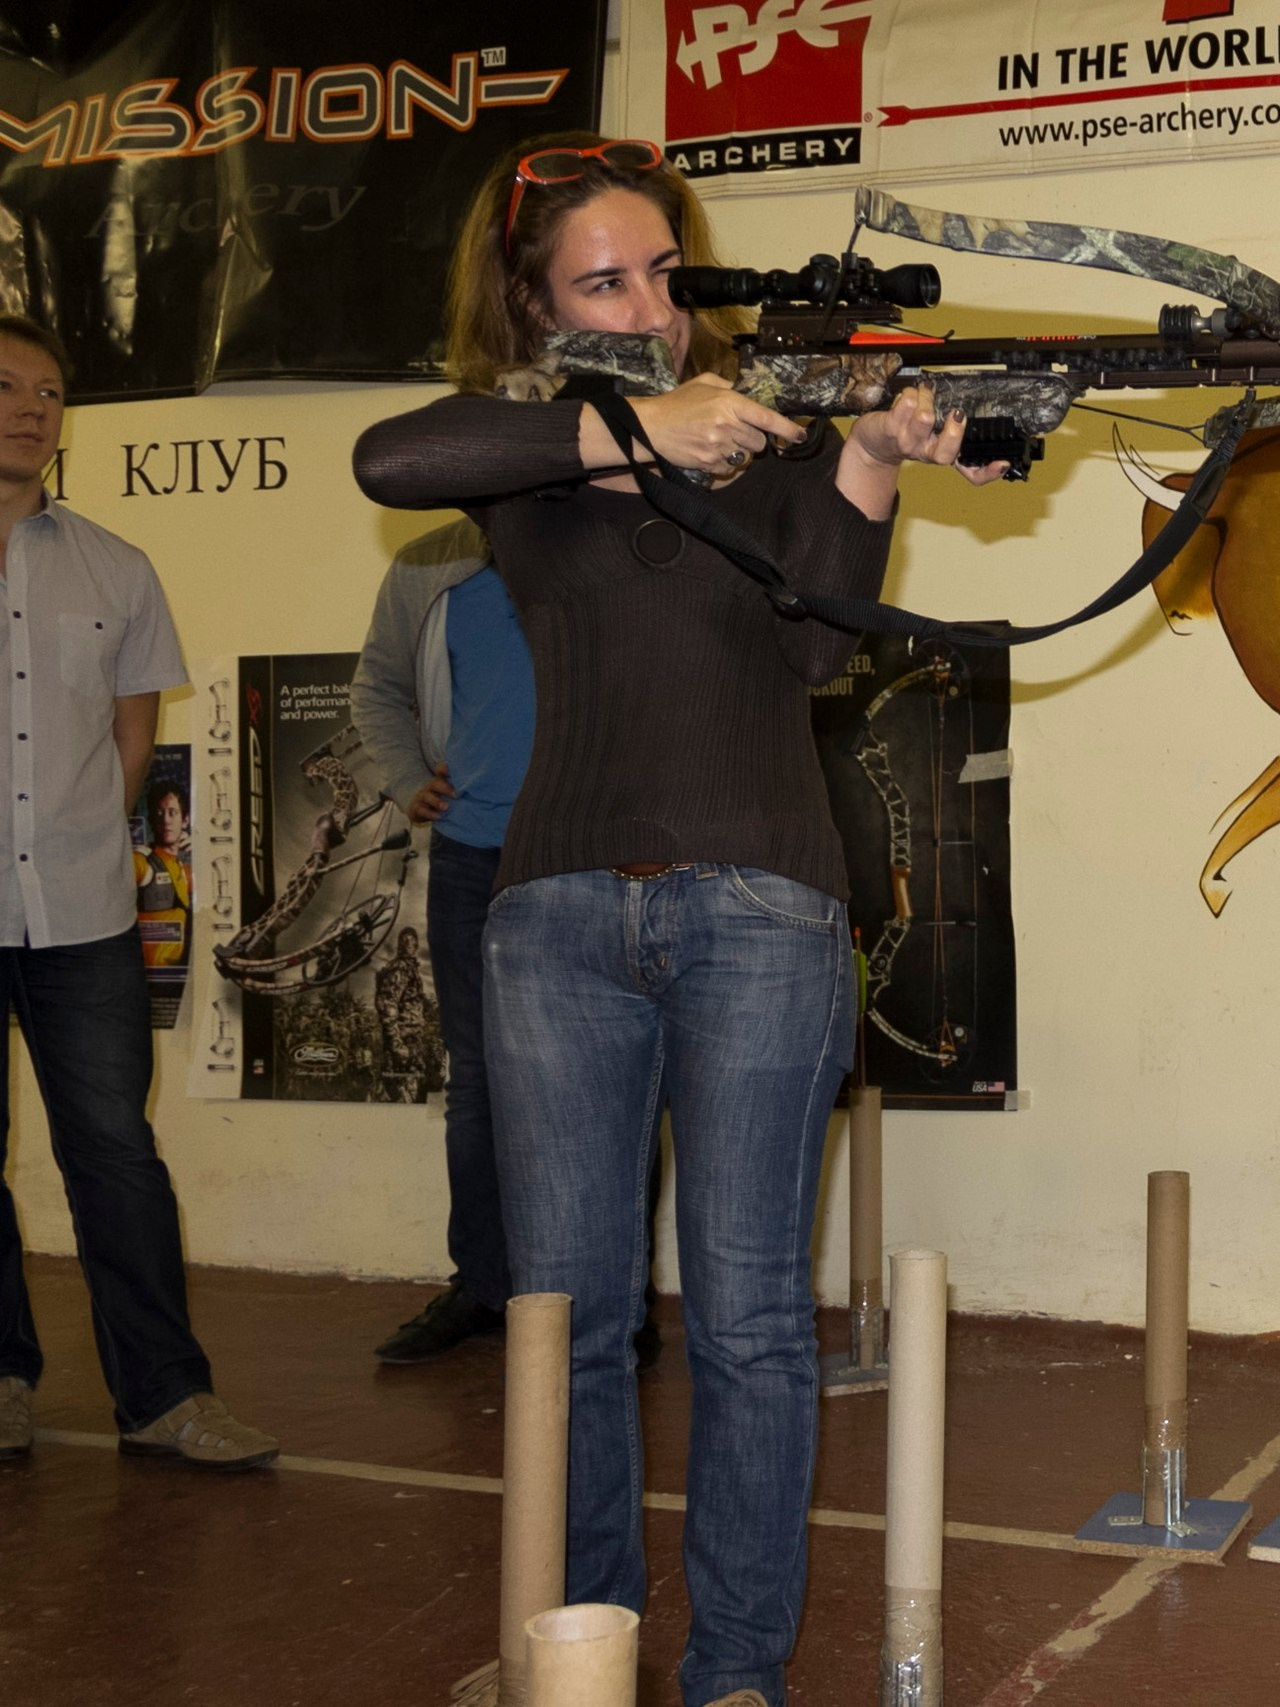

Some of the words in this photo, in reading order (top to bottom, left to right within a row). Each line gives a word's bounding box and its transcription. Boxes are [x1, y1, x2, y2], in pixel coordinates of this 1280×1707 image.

[998, 52, 1039, 90] IN
[1055, 42, 1128, 85] THE
[674, 138, 854, 172] ARCHERY
[121, 437, 288, 497] КЛУБ
[280, 685, 290, 696] A
[292, 684, 330, 697] perfect
[280, 698, 291, 708] of
[295, 697, 353, 709] performan
[280, 710, 301, 720] and
